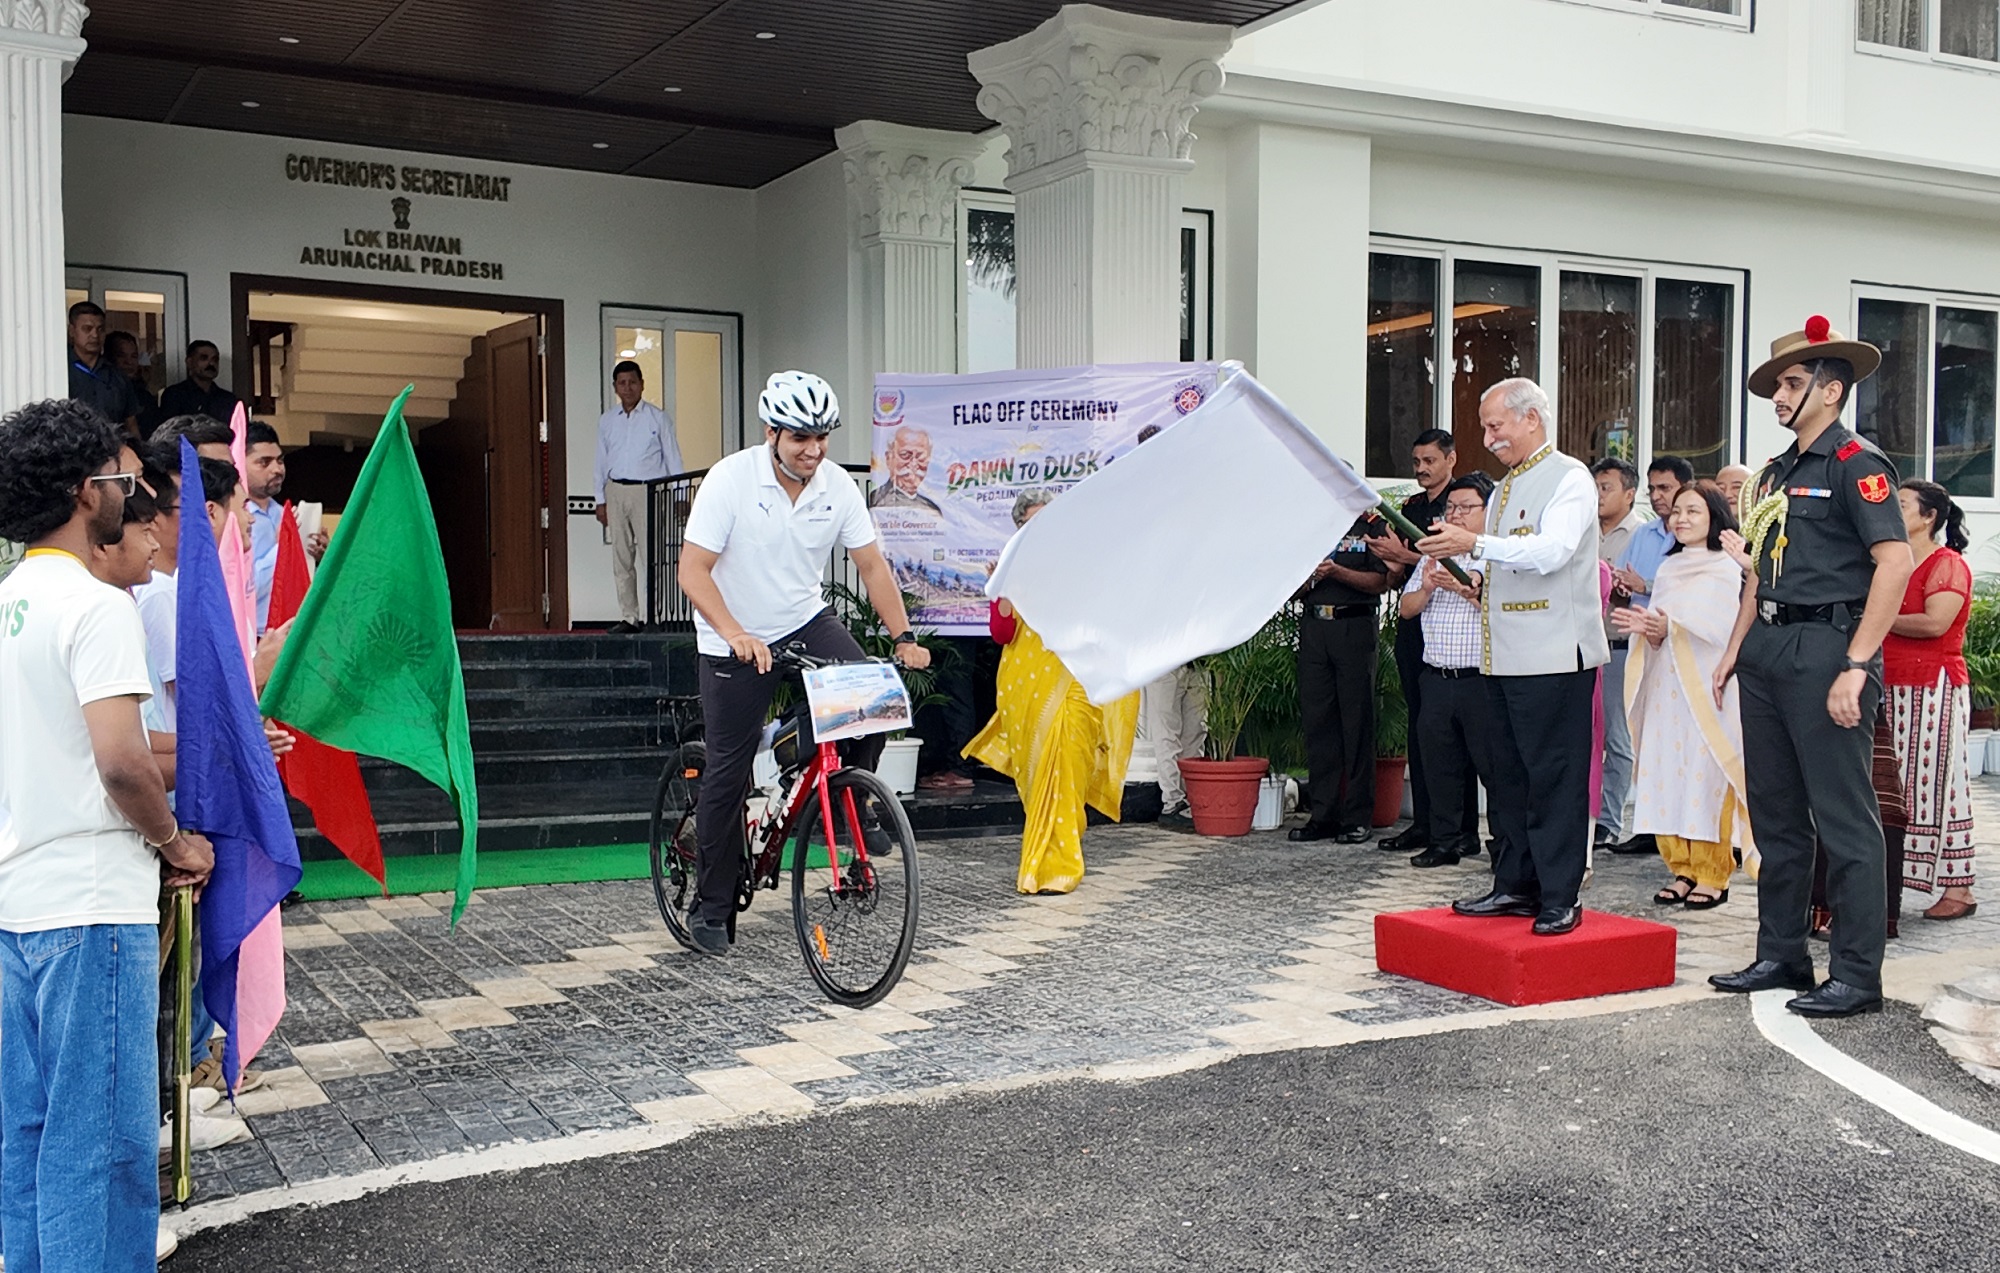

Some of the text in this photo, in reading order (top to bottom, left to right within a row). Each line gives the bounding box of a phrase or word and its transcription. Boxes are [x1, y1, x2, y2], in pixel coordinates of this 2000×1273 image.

[285, 153, 511, 202] GOVERNOR'S SECRETARIAT
[344, 228, 462, 255] LOK BHAVAN
[300, 247, 504, 280] ARUNACHAL PRADESH
[953, 399, 1119, 426] FLAG OFF CEREMONY
[1027, 423, 1039, 433] for
[946, 450, 1103, 492] DAWN TO DUSK
